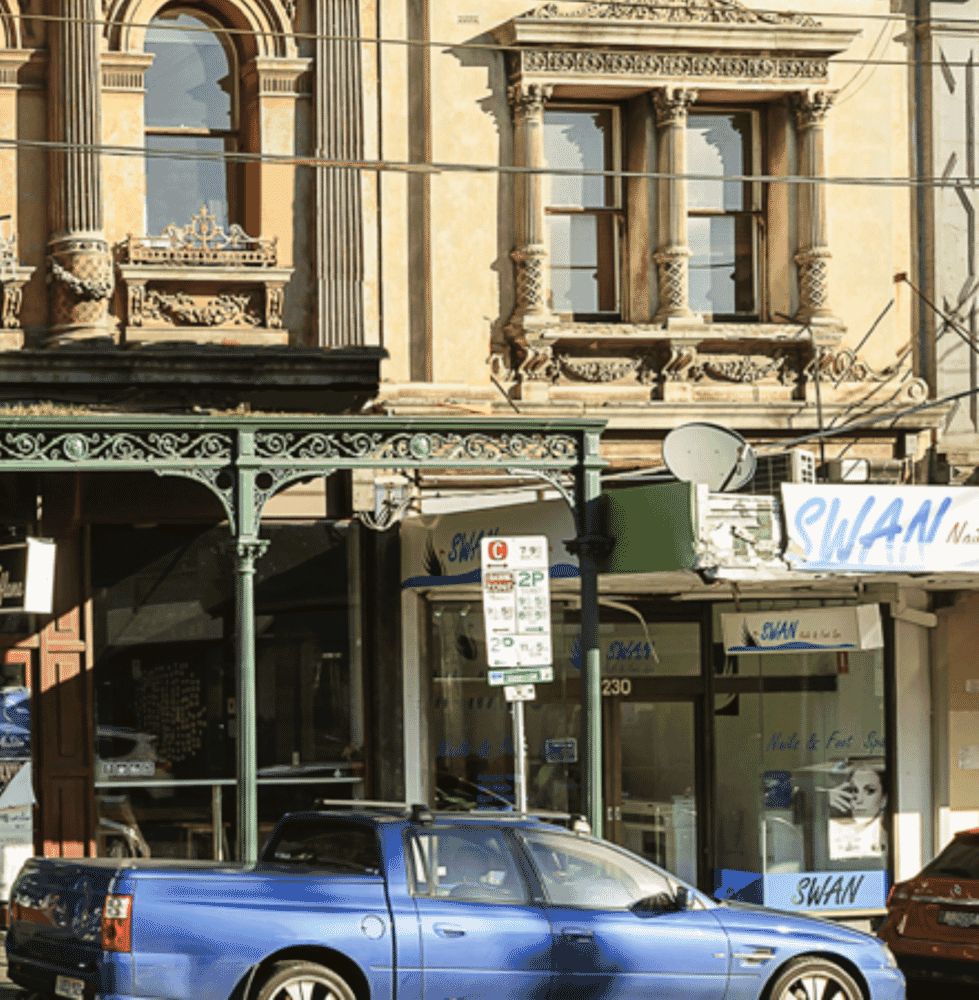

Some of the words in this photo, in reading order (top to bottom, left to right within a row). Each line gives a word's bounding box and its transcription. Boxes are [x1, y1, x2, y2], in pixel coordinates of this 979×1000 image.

[795, 496, 952, 561] SWAN
[448, 527, 499, 562] SWA
[519, 571, 544, 587] 2P
[761, 619, 799, 640] SWAN
[602, 679, 631, 695] 230
[791, 875, 864, 905] SWAN
